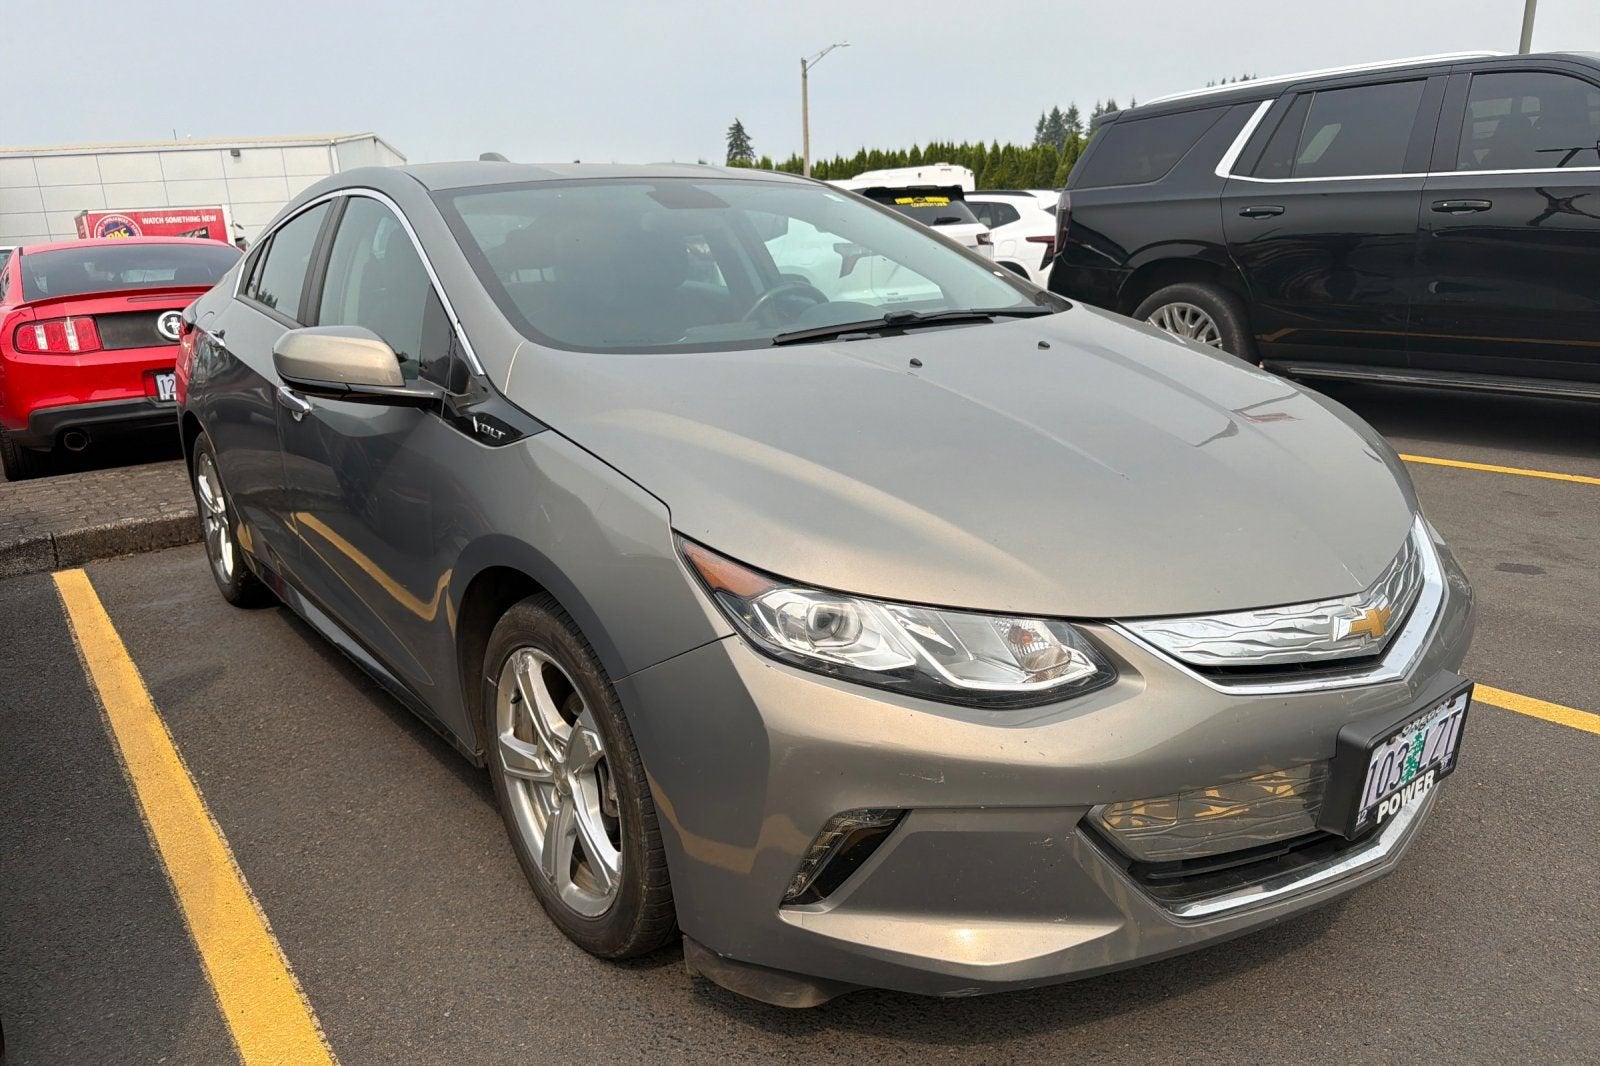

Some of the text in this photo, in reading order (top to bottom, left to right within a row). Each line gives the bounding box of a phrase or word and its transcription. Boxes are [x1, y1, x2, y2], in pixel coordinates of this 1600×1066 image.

[141, 214, 217, 225] WATCH SOMETHING NEW
[473, 416, 506, 439] VOLT
[1377, 769, 1435, 824] POWER
